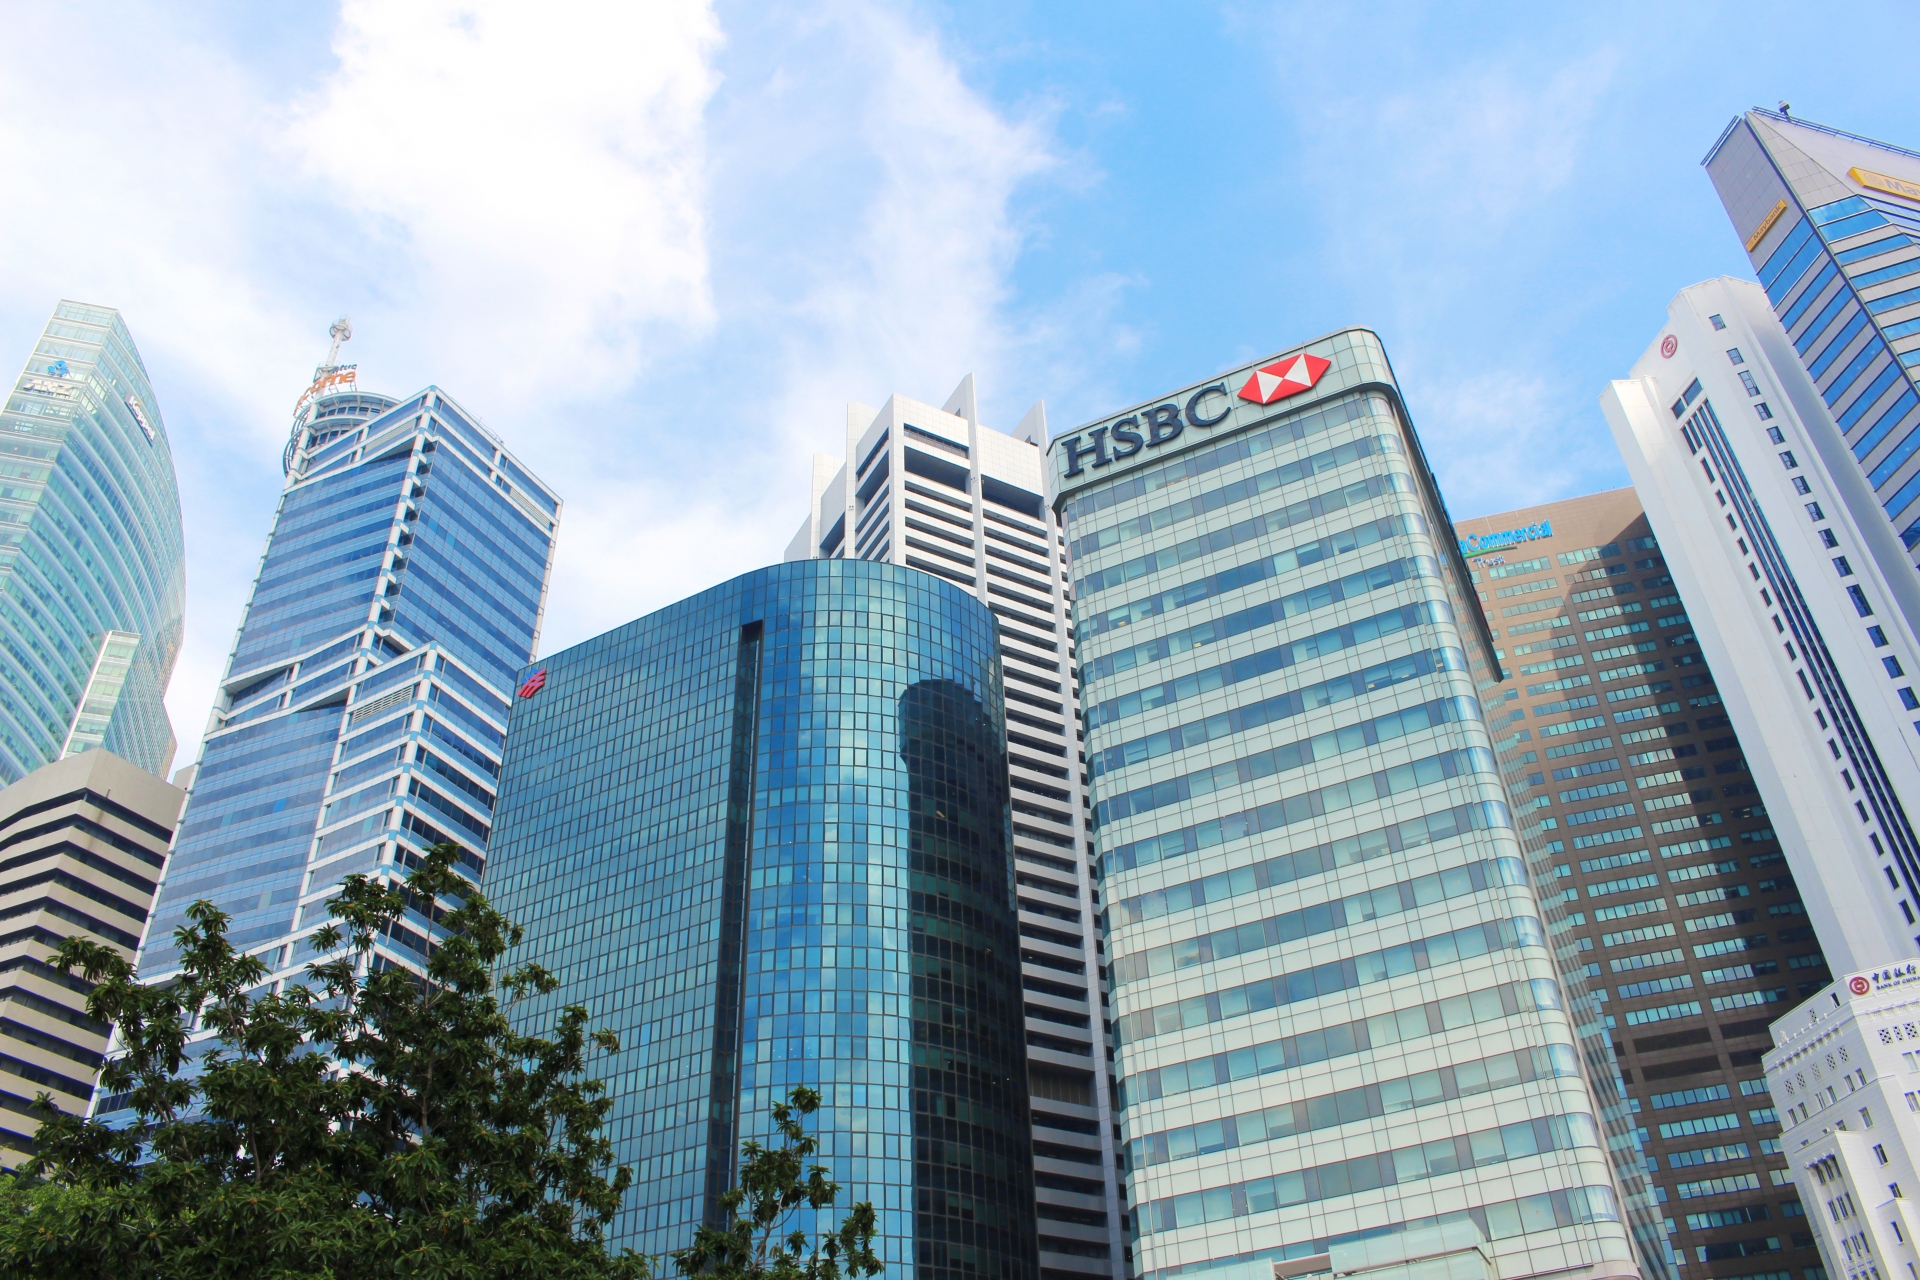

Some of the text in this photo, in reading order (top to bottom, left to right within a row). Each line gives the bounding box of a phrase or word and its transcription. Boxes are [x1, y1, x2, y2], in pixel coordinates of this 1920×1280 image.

[1753, 205, 1782, 241] Maybank
[23, 379, 74, 396] ANZ
[129, 395, 156, 441] Keppel
[1061, 381, 1231, 479] HSBC
[1473, 554, 1506, 569] Trust
[1876, 981, 1893, 991] BANK
[1893, 979, 1901, 987] OF
